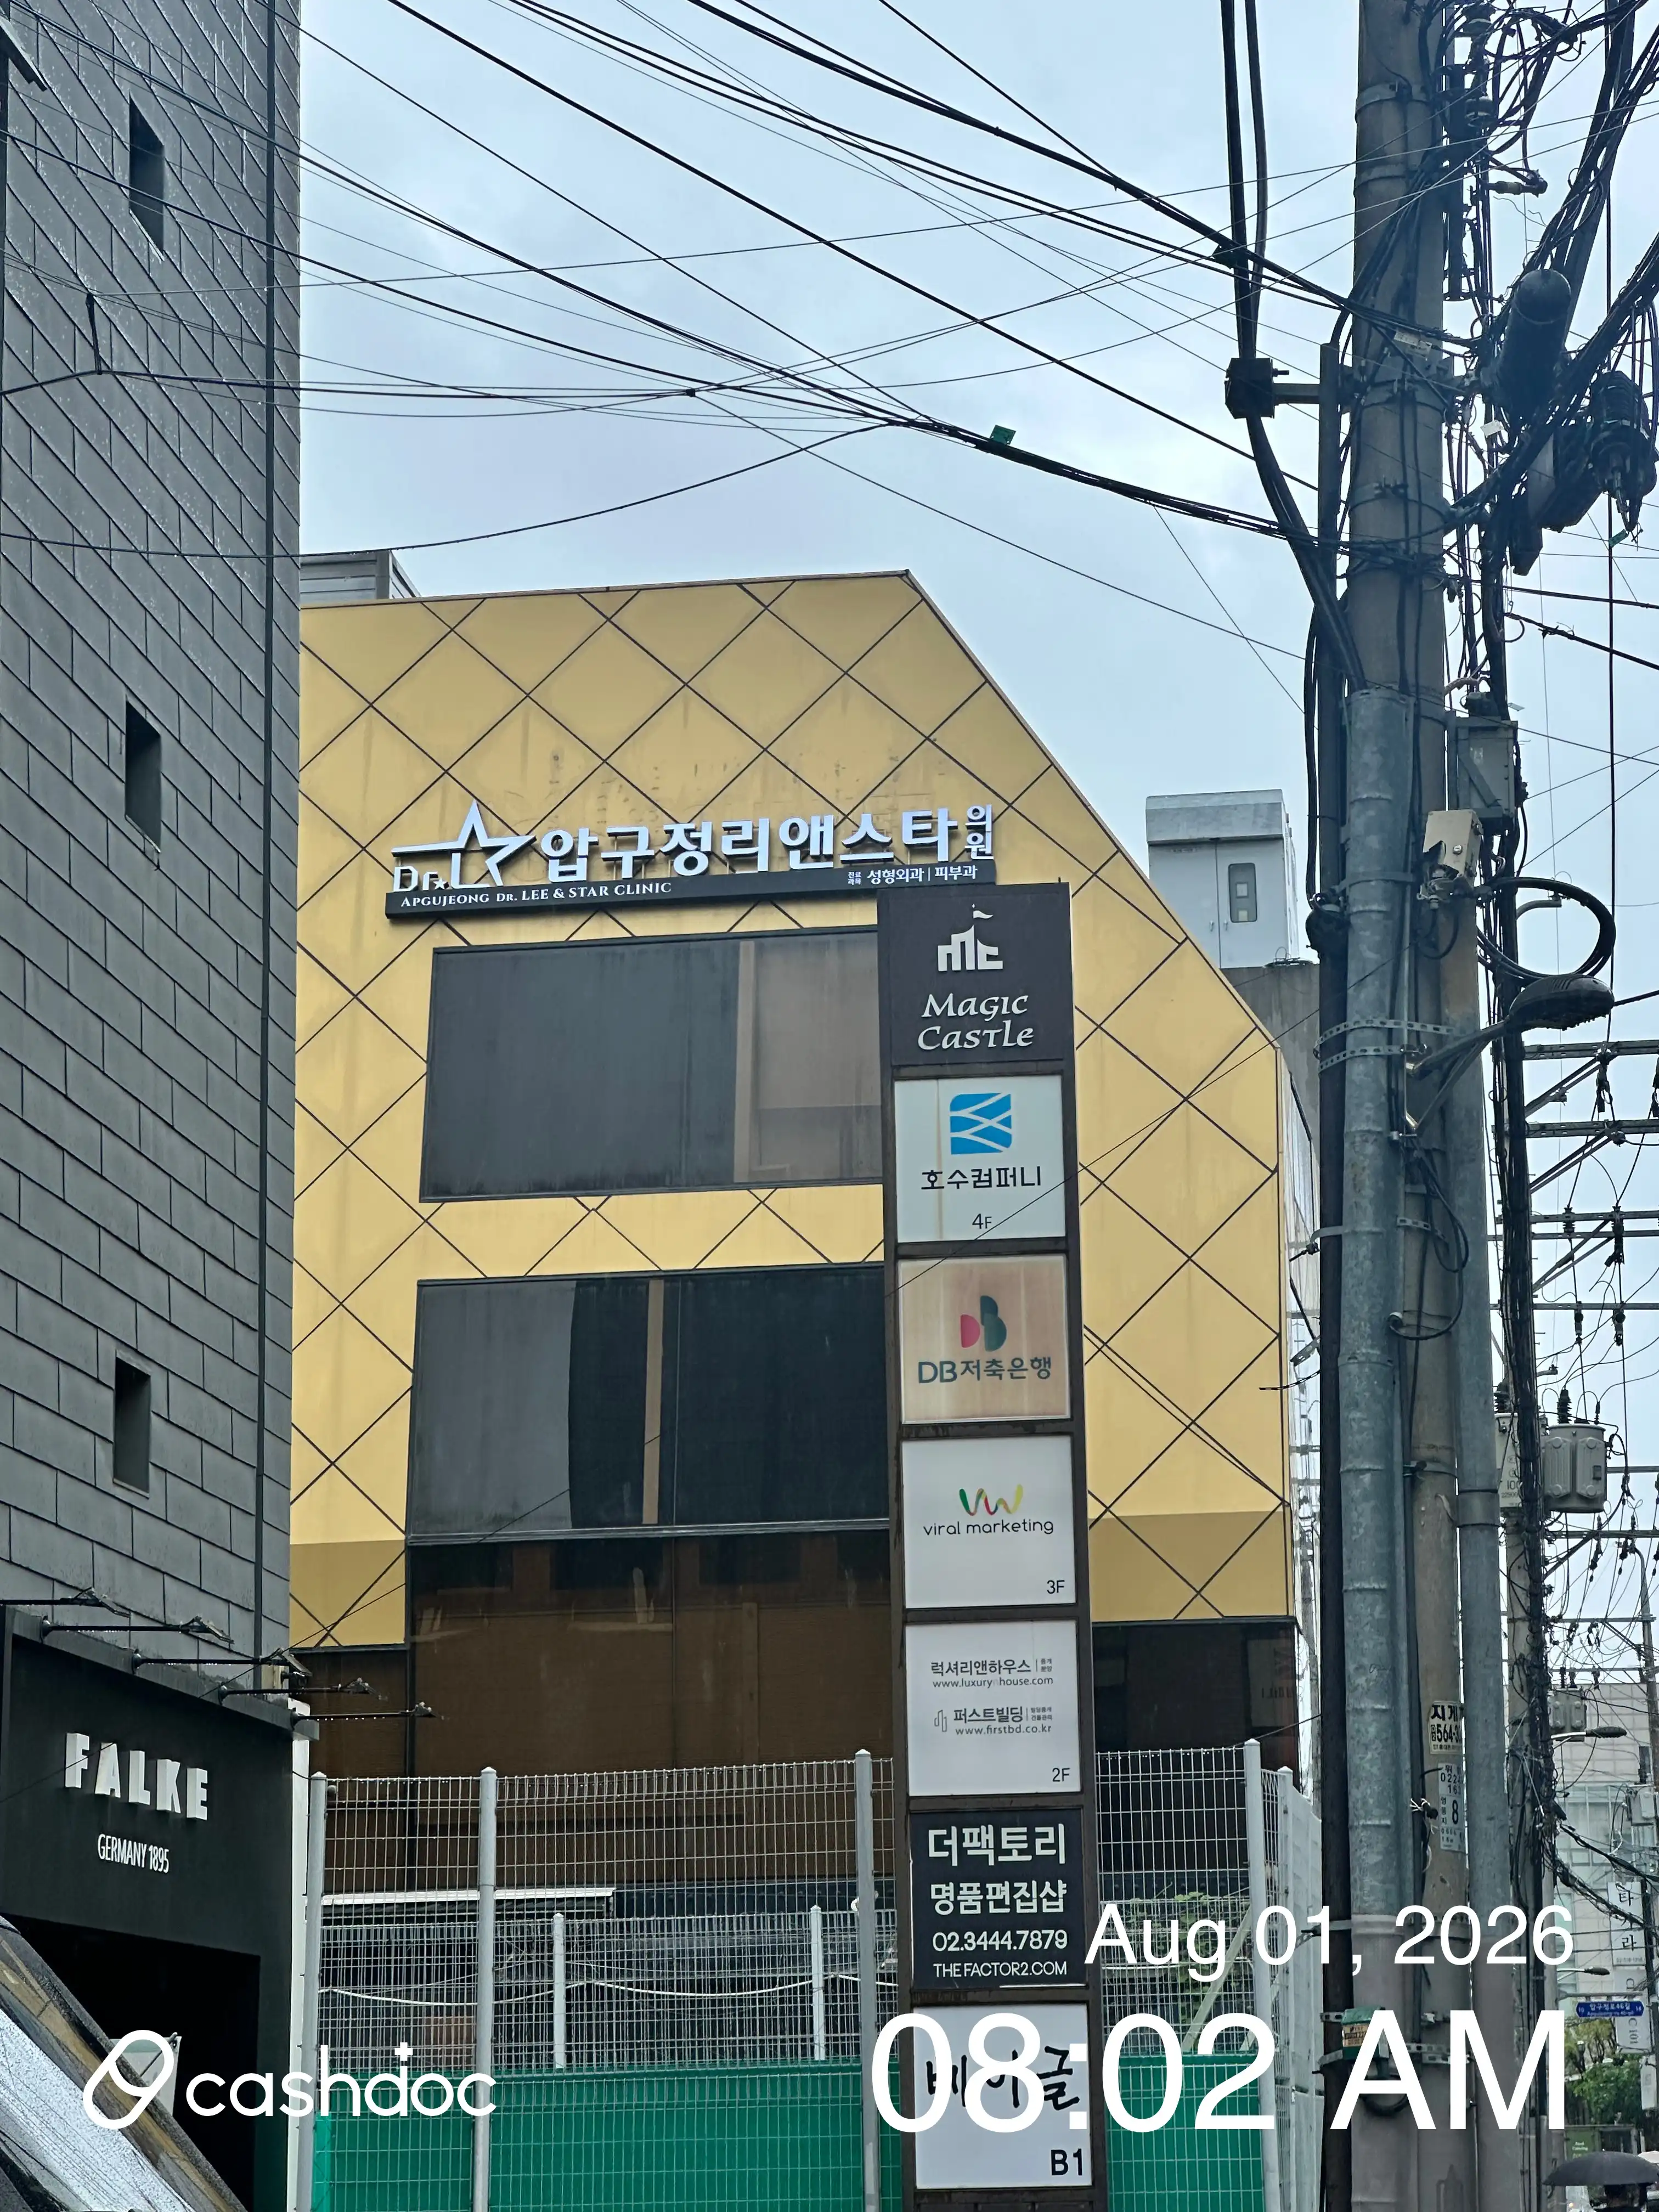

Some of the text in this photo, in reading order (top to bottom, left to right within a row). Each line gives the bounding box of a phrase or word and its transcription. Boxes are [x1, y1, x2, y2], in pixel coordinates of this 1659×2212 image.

[541, 808, 958, 883] 압구정리앤스타
[867, 865, 978, 885] 성형외과 피부과
[522, 888, 549, 901] LEE
[552, 888, 565, 899] &
[569, 885, 609, 898] STAR
[613, 882, 672, 895] CLINIC
[922, 993, 1029, 1022] Magic
[918, 1020, 1034, 1050] Castle
[921, 1166, 1041, 1190] 호수컴퍼니
[972, 1213, 992, 1229] 4F
[918, 1356, 1052, 1384] DB저축은행
[923, 1519, 1054, 1536] viral marketing
[1047, 1579, 1065, 1594] 3F
[931, 1659, 1031, 1677] 럭셔리앤하우스
[953, 1706, 1023, 1724] 퍼스트빌딩
[955, 1723, 1052, 1735] www.firstbd.co.kr
[65, 1733, 208, 1820] FALKE
[1052, 1767, 1070, 1782] 2F
[1452, 1800, 1458, 1825] 8
[98, 1833, 170, 1874] GERMANY 1895
[928, 1823, 1065, 1866] 더팩토리
[930, 1879, 1067, 1915] 명품편집샵
[932, 1929, 1068, 1951] 02.3444.7879
[1051, 2148, 1083, 2176] B1
